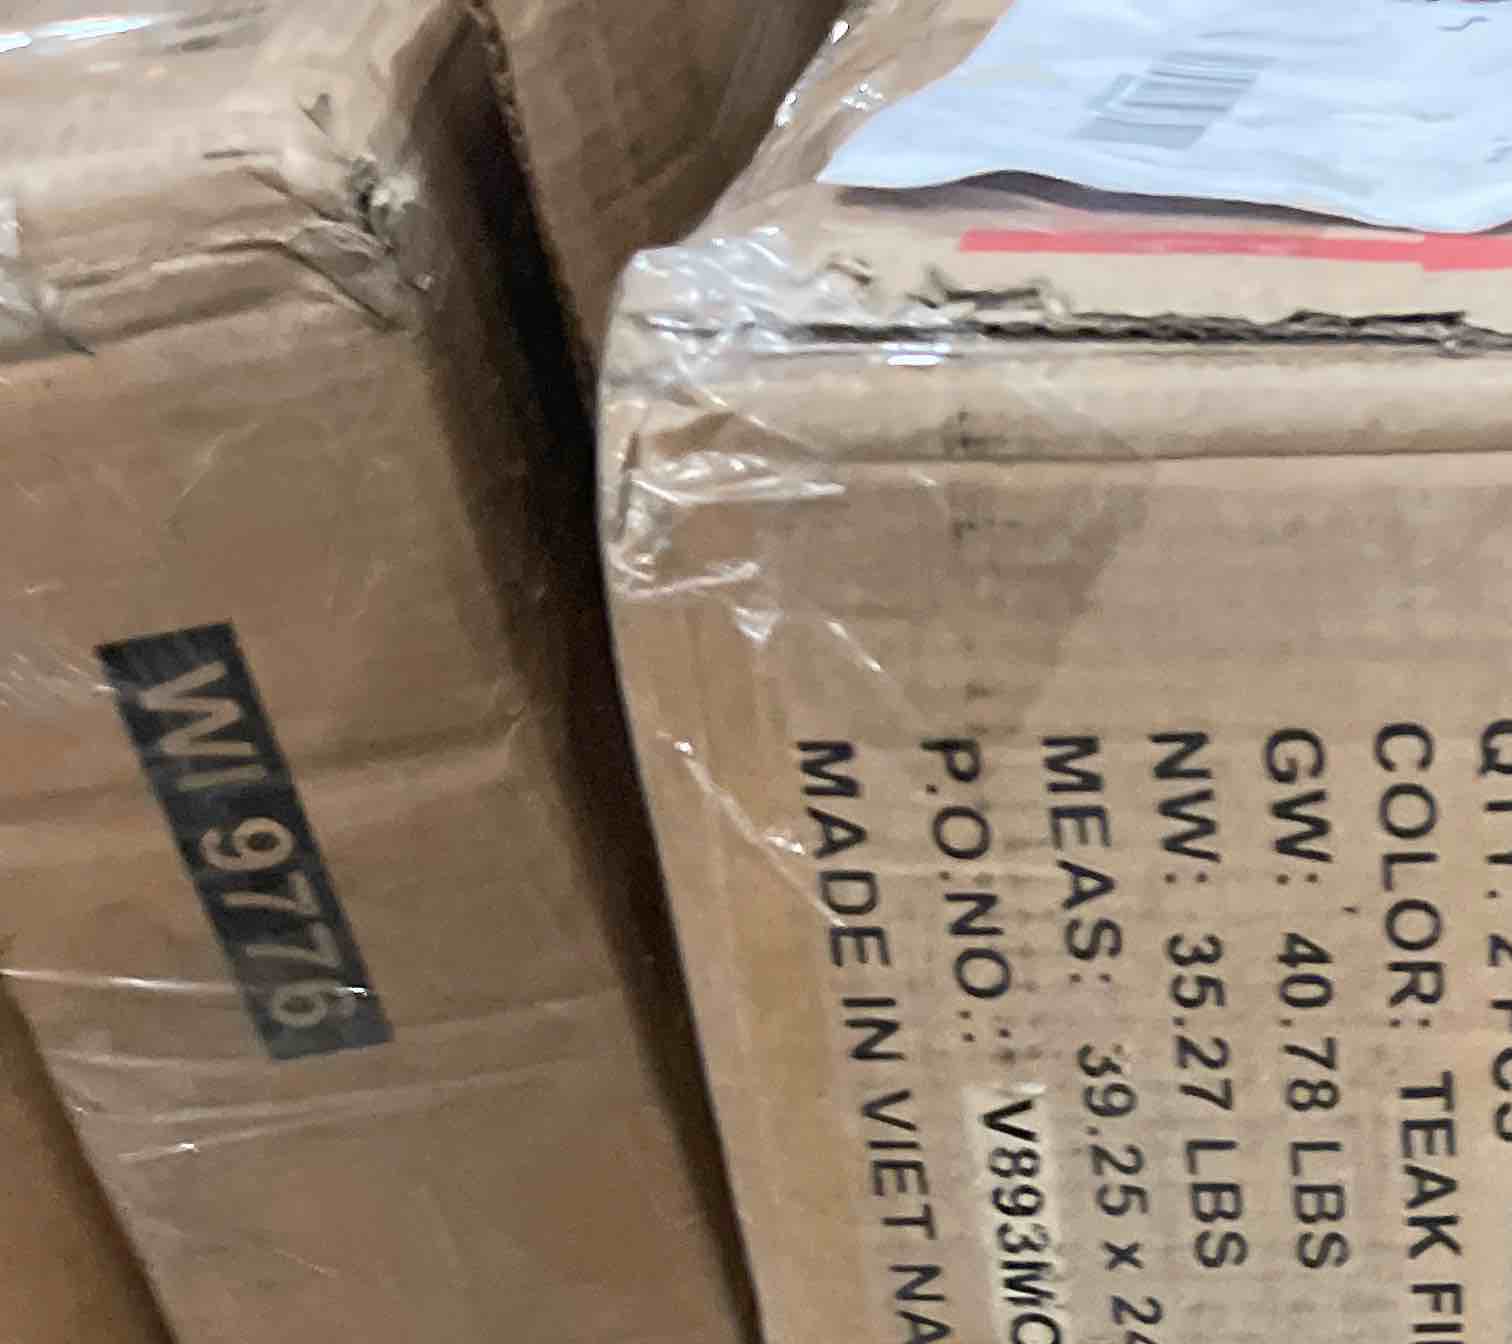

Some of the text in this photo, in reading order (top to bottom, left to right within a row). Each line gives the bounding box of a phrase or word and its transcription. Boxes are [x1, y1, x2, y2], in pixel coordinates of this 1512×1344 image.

[796, 740, 889, 968] MADE
[1042, 734, 1121, 985] MEAS:
[1376, 723, 1443, 1031] COLOR:
[840, 996, 915, 1061] IN
[1151, 733, 1245, 1269] NW: 35.27 LBS
[1263, 730, 1348, 1270] GW: 40.78 LBS
[859, 1091, 938, 1241] VIET
[1074, 1044, 1149, 1217] 39.25
[1399, 1072, 1458, 1257] TEAK
[1104, 1241, 1143, 1271] x
